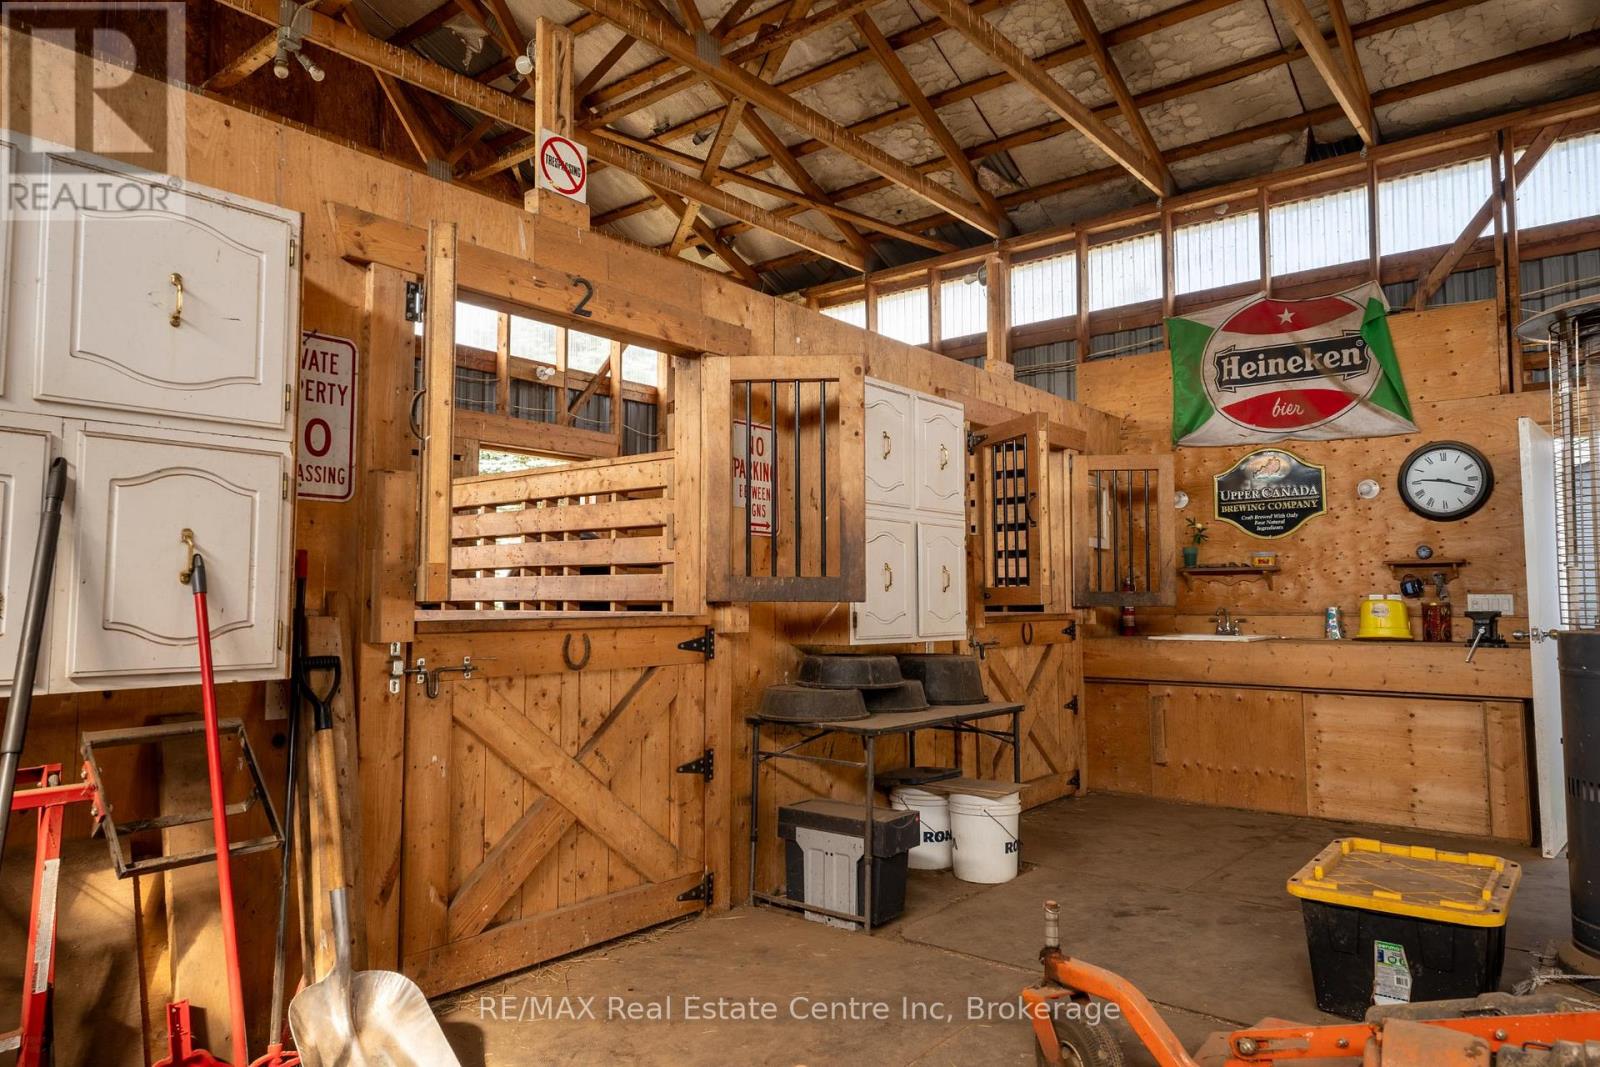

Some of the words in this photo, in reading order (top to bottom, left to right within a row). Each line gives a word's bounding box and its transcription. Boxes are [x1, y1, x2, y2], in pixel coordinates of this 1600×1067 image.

[545, 153, 581, 178] TRESSING
[572, 277, 593, 317] 2
[1221, 347, 1362, 381] Heineken
[302, 379, 348, 407] ERTY
[1272, 397, 1305, 417] bier
[734, 458, 773, 482] PAKIN
[739, 484, 771, 501] BWEEN
[1221, 503, 1266, 513] BREWING
[1267, 500, 1318, 510] COMPANY
